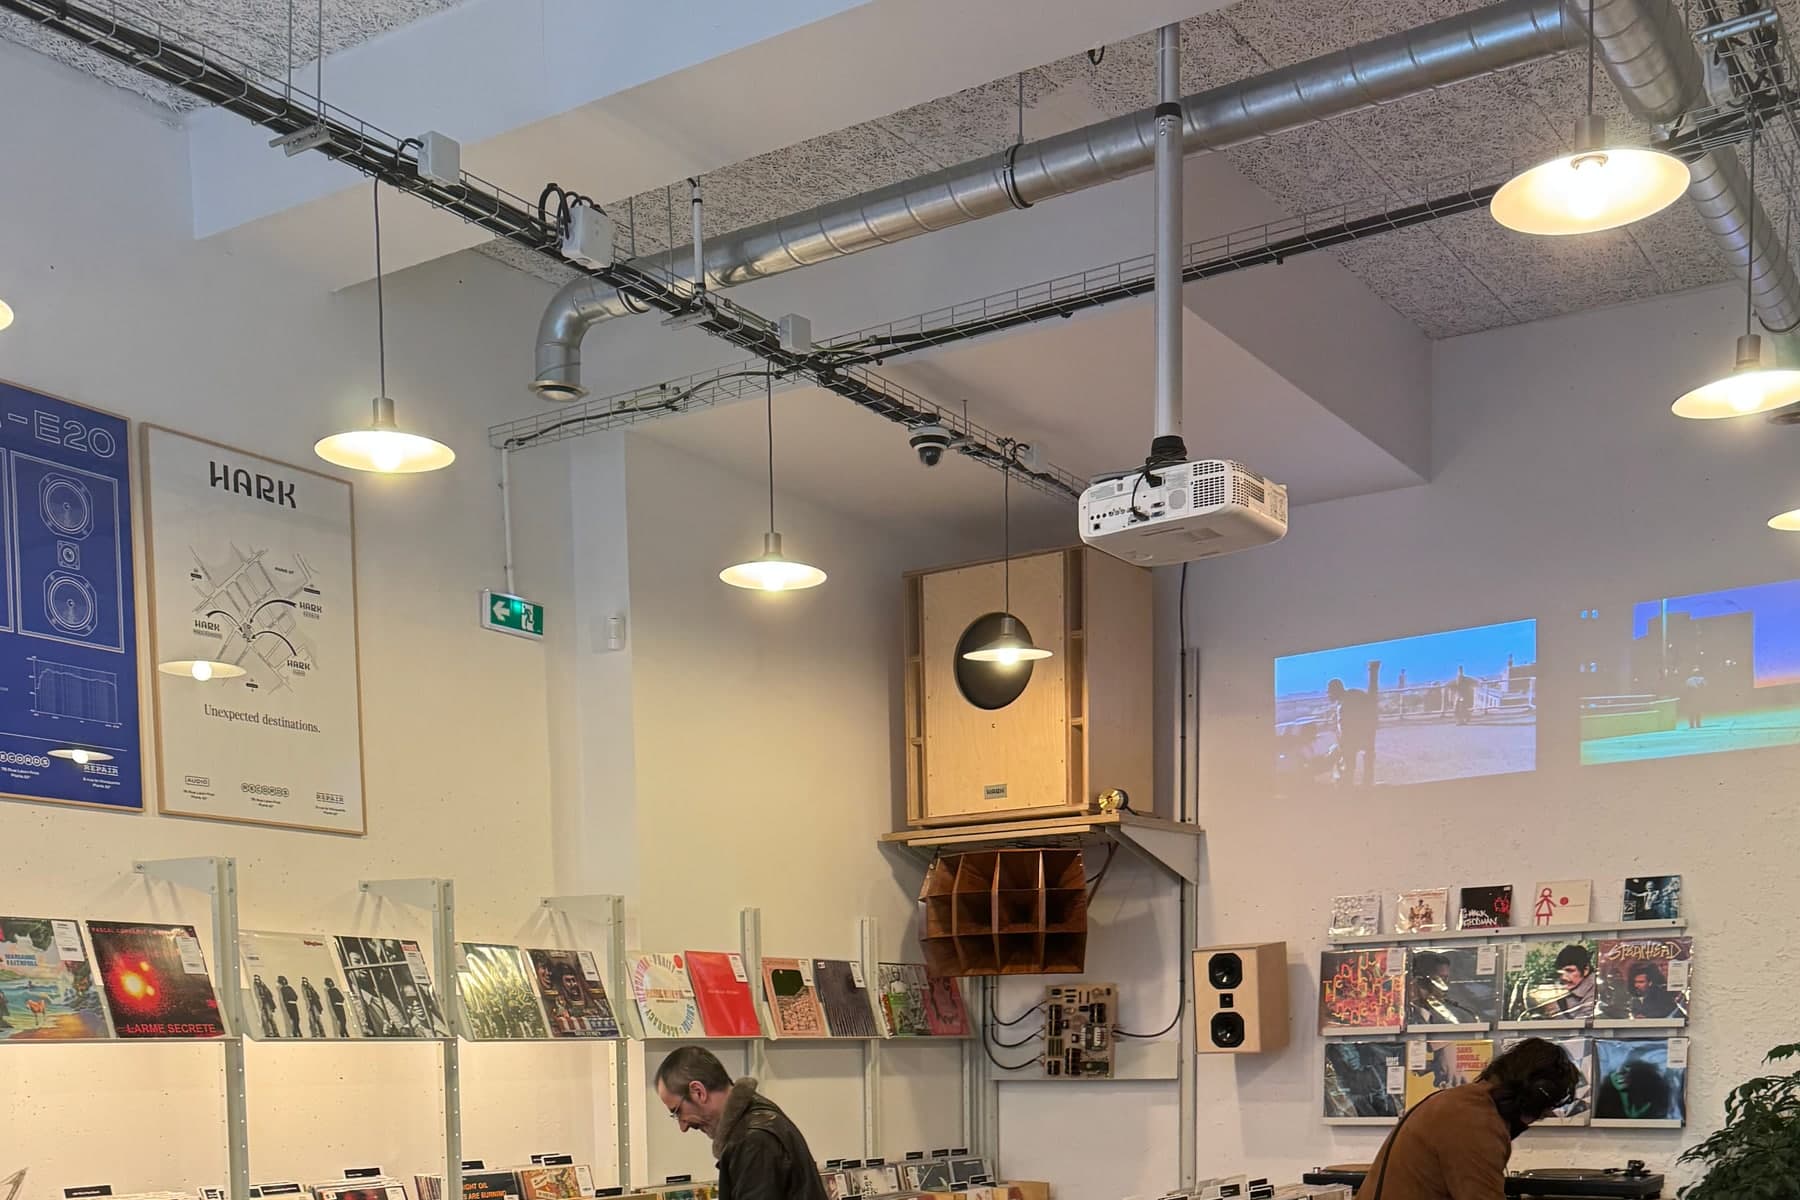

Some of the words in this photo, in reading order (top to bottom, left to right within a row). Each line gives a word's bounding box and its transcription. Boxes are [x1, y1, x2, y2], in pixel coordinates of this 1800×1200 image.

[0, 409, 116, 458] -E20
[209, 460, 297, 509] HARK
[299, 601, 323, 614] HARK
[194, 619, 221, 632] HARK
[287, 659, 311, 671] HARK
[203, 703, 260, 723] Unexpected
[261, 713, 321, 734] destinations.
[83, 764, 119, 776] REPAIR
[167, 1023, 217, 1033] SECRETE
